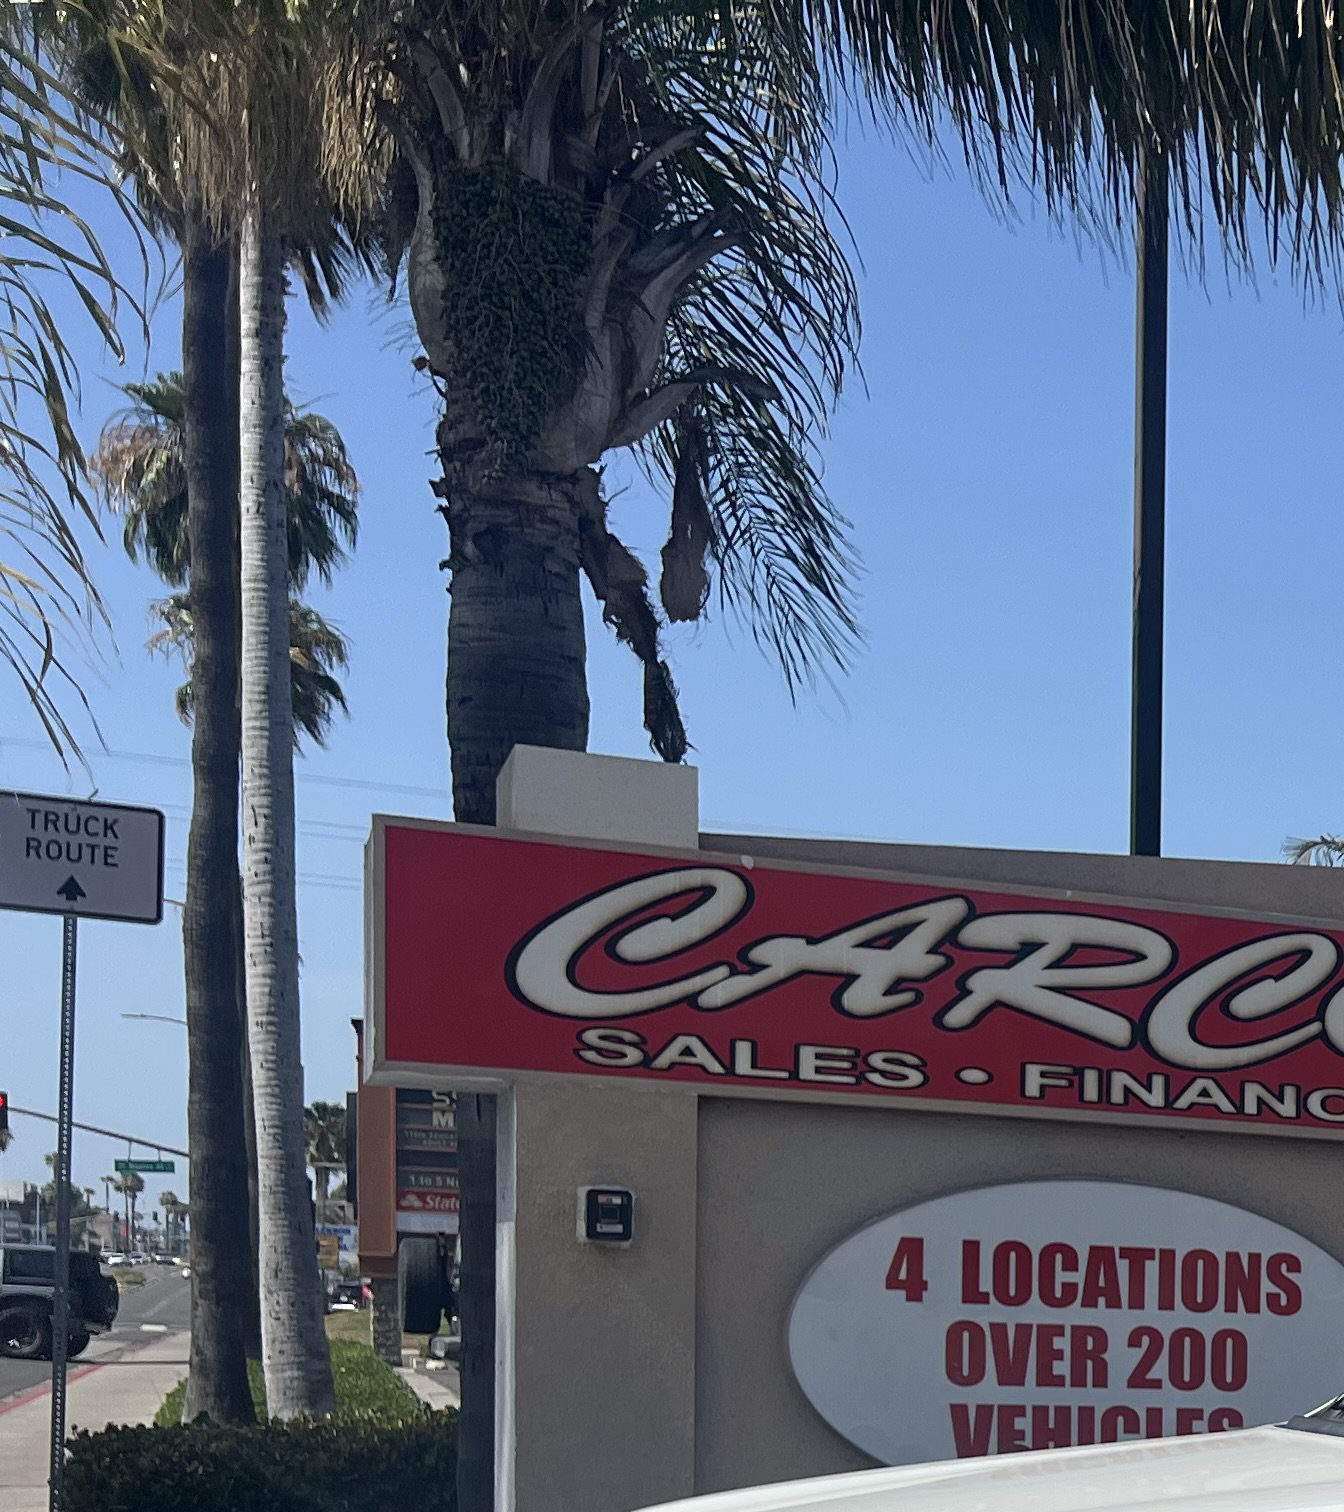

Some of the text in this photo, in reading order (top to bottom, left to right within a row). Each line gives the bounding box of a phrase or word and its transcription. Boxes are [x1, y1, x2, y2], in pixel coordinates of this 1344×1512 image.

[25, 837, 119, 868] ROUTE
[26, 808, 119, 839] TRUCK
[574, 1026, 930, 1090] SALES
[885, 1237, 1302, 1316] 4 LOCATIONS
[945, 1320, 1248, 1392] OVER 200
